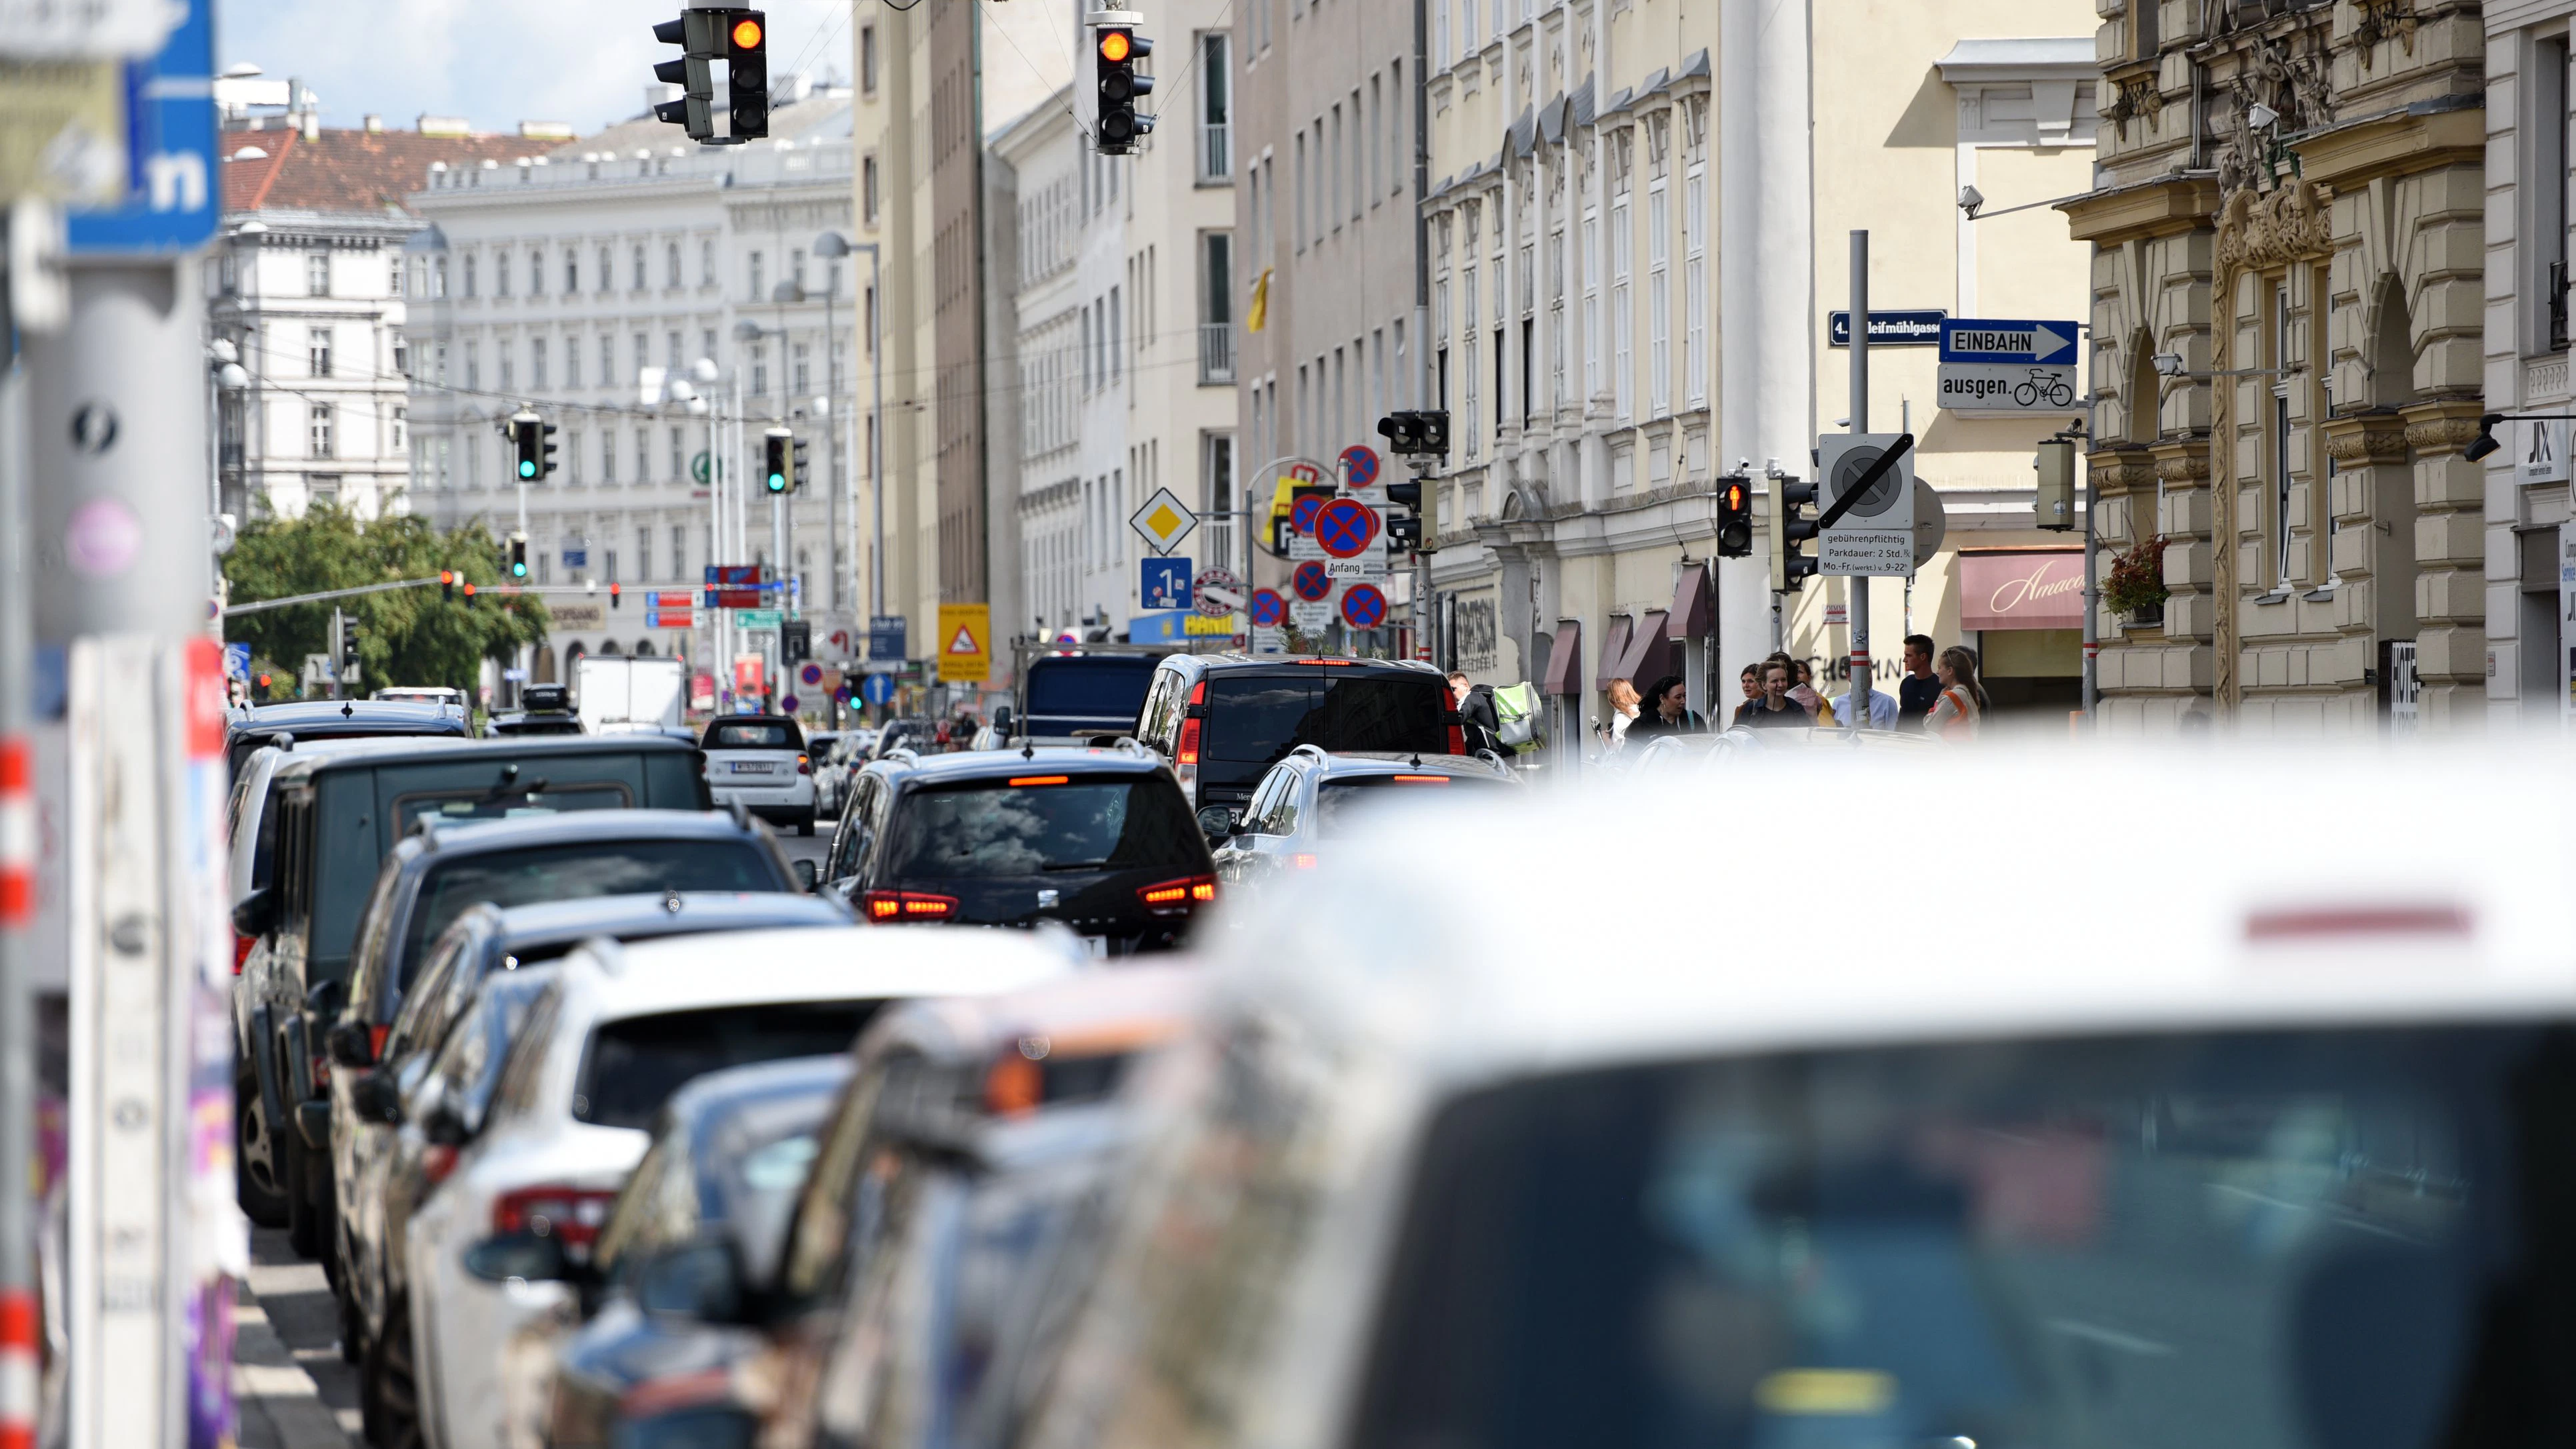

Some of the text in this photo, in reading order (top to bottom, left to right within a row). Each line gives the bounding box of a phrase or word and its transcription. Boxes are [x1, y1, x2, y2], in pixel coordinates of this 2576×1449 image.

[1955, 332, 2032, 352] EINBAHN
[1943, 378, 2012, 399] ausgen.
[1827, 534, 1905, 545] gebührenpflichtig
[1829, 549, 1903, 558] Parkdauer: 2 Std.
[1329, 563, 1360, 574] Anfang
[1991, 560, 2085, 613] Amaco
[1236, 792, 1251, 801] Mer
